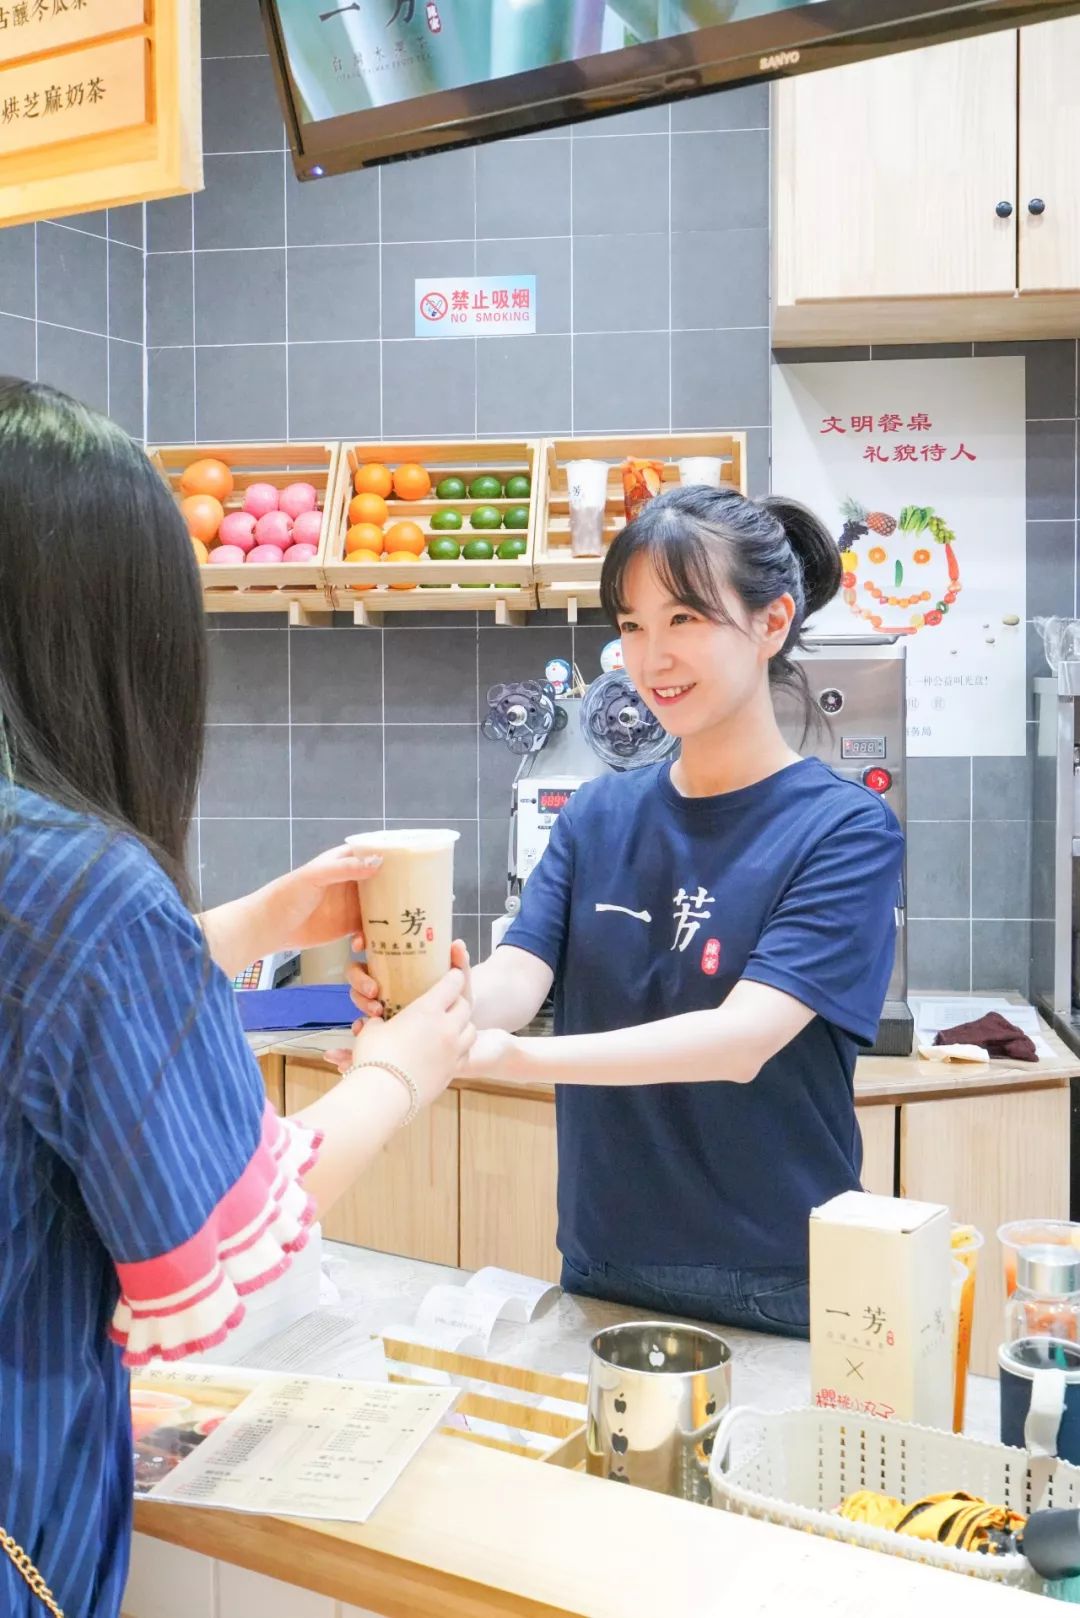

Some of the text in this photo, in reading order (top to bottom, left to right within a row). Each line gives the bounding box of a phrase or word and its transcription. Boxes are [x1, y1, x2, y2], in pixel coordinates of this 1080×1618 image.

[760, 50, 800, 70] SANYO
[2, 77, 106, 124] 烘芝麻奶茶
[452, 288, 530, 311] 禁止吸烟
[451, 311, 530, 323] NO SMOKING
[820, 413, 932, 434] 文明餐桌
[863, 443, 977, 462] 礼貌待人
[368, 907, 426, 936] 一芳
[595, 886, 716, 952] 一芳
[825, 1305, 886, 1335] 一芳
